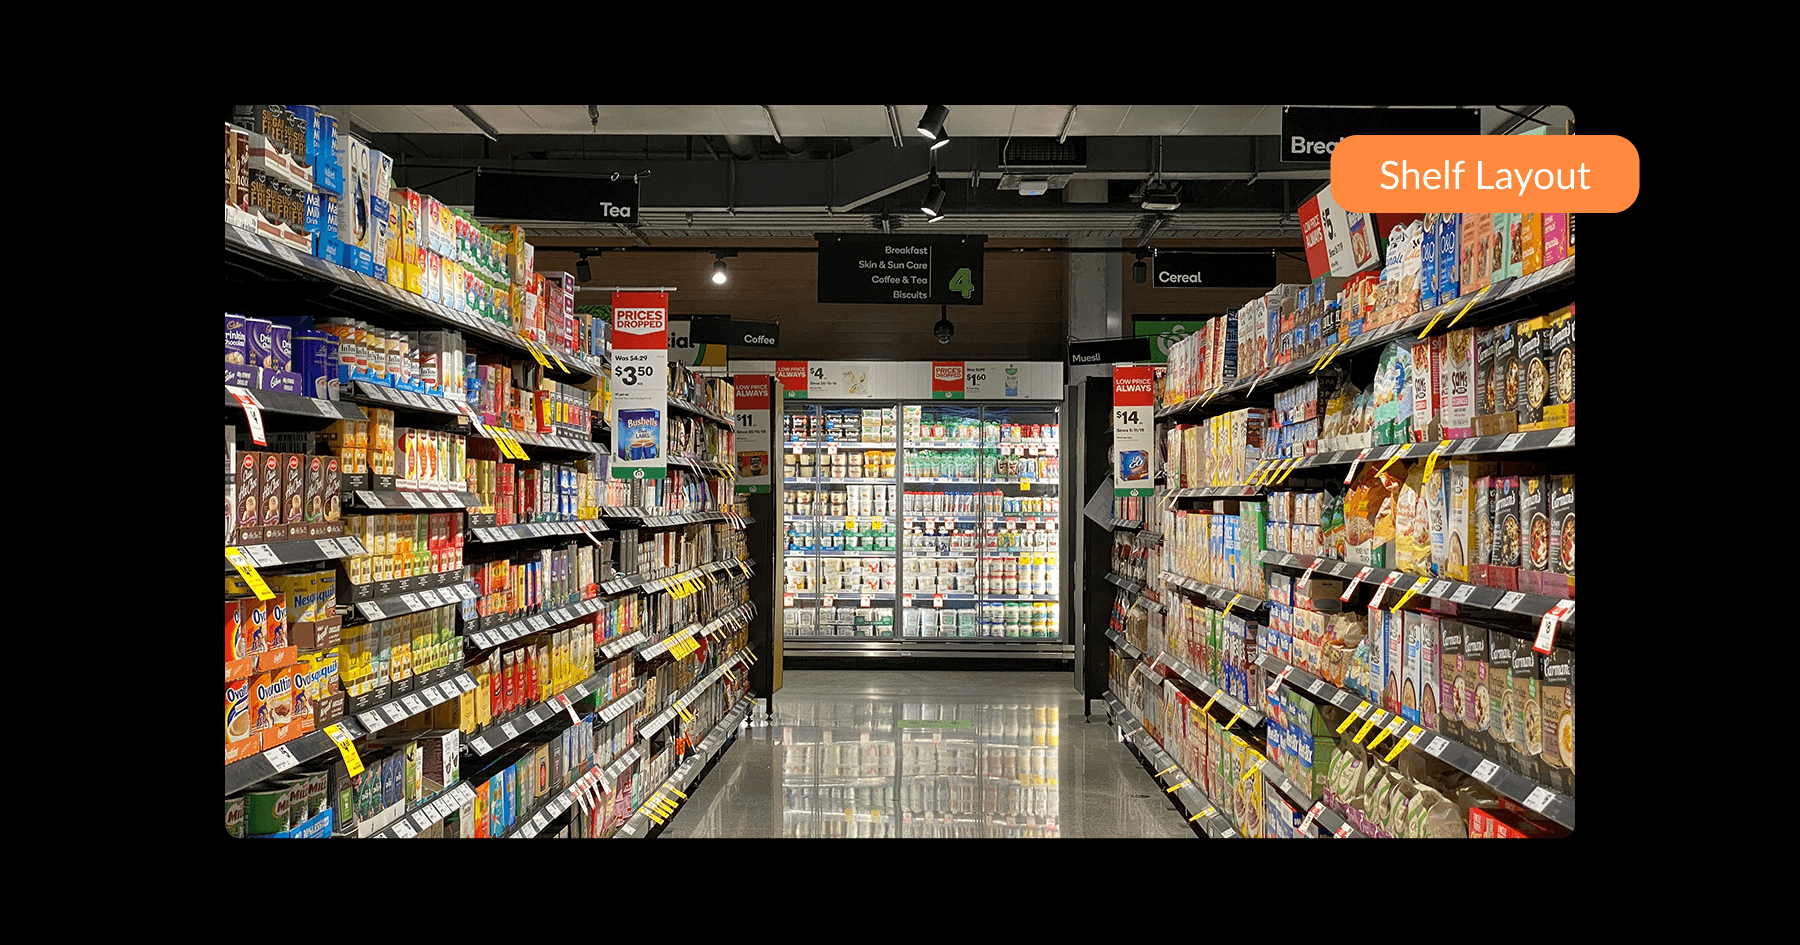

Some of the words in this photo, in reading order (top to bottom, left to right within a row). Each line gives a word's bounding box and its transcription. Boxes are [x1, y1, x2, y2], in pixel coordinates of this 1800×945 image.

[1291, 135, 1344, 154] Brea
[599, 202, 631, 217] Tea
[885, 245, 928, 255] Breakfast
[858, 260, 877, 269] Skin
[879, 260, 886, 269] &
[887, 260, 905, 269] Sun
[906, 261, 928, 270] Care
[871, 275, 901, 284] Coffee
[902, 275, 909, 284] &
[910, 276, 928, 284] Tea
[1158, 270, 1202, 283] Cereal
[948, 267, 975, 299] 4
[893, 290, 928, 299] Biscuits
[617, 310, 663, 320] PRICES
[617, 320, 663, 328] DROPPED
[744, 333, 775, 345] Coffee
[1072, 353, 1101, 363] Muesli
[809, 367, 824, 380] $4
[735, 389, 769, 397] ALWAYS
[1115, 384, 1152, 392] ALWAYS
[627, 416, 658, 429] Bushells
[736, 413, 753, 427] $11
[1116, 410, 1140, 425] $14
